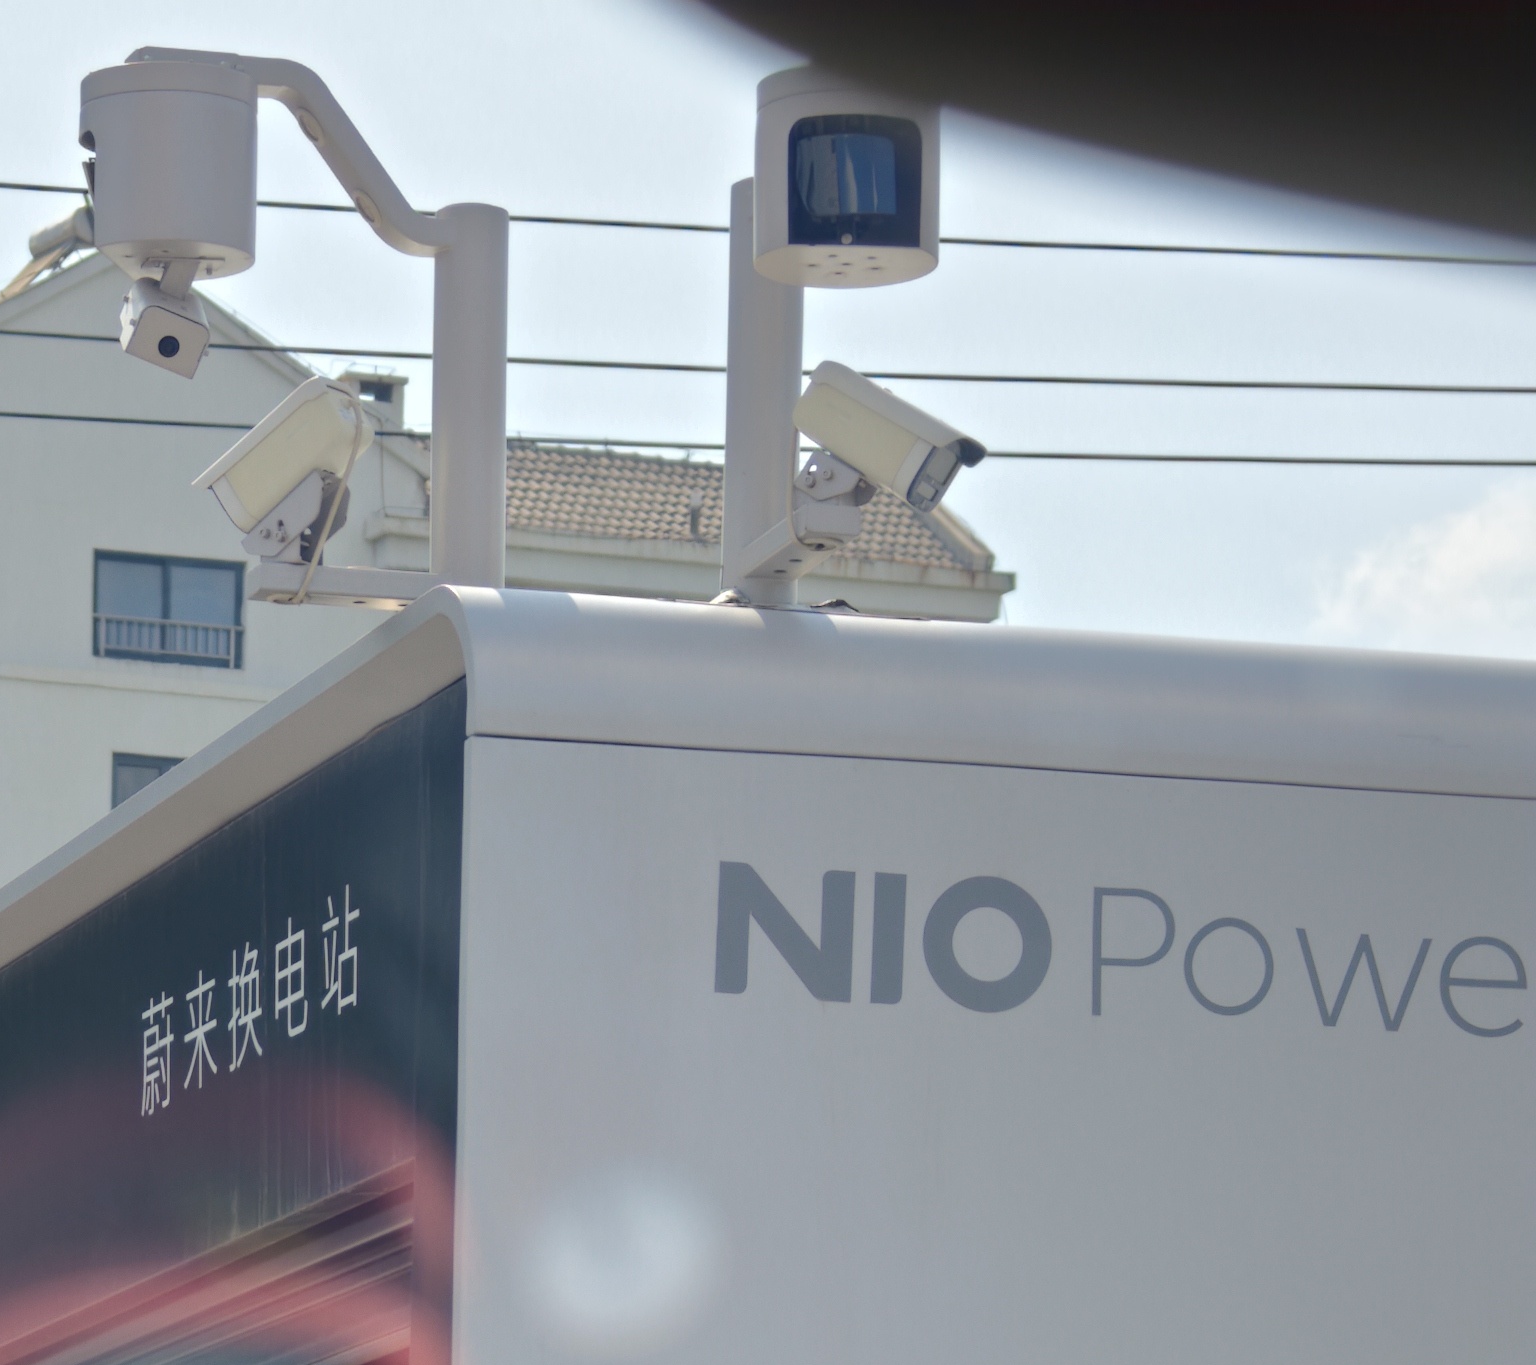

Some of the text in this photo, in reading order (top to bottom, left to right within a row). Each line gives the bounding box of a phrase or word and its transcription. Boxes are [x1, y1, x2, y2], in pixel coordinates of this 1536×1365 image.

[141, 883, 361, 1117] 蔚来换电站
[714, 860, 1529, 1038] NIO Powe
